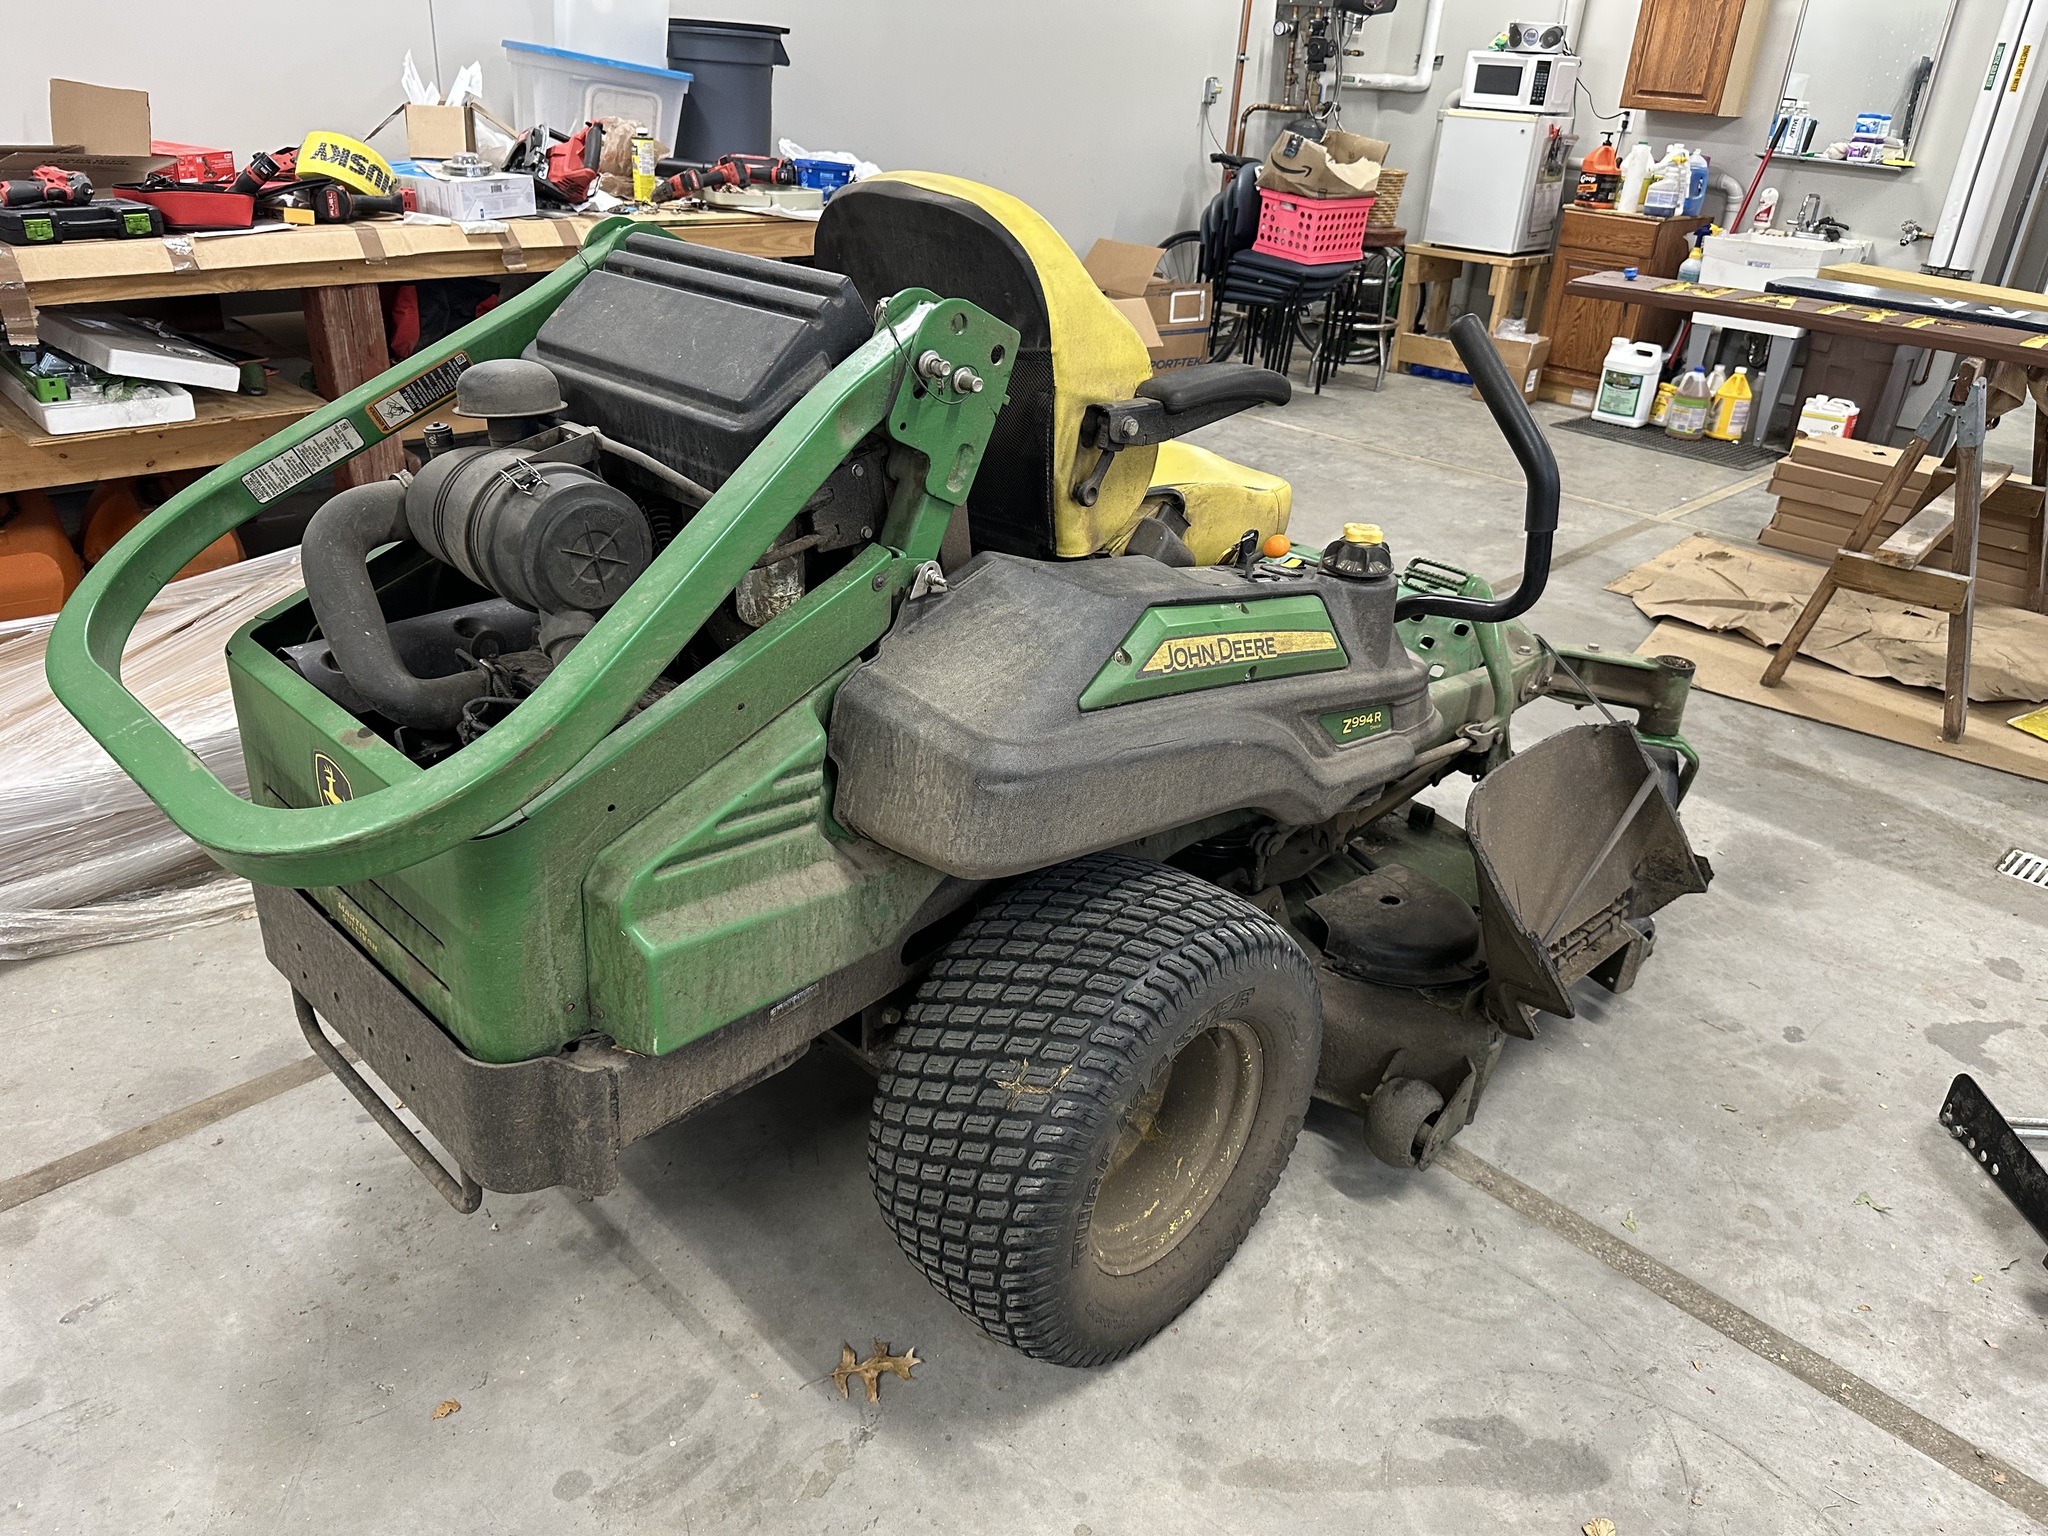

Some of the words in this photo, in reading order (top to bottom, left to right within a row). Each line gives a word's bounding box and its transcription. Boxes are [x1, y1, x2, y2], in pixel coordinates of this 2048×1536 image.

[310, 142, 398, 196] HUSKY
[1149, 356, 1203, 370] PORT-TEK
[1164, 644, 1216, 670] JOHN
[1217, 637, 1278, 662] DEERE
[338, 901, 368, 935] MARTIN
[342, 913, 378, 953] SULLIVAN
